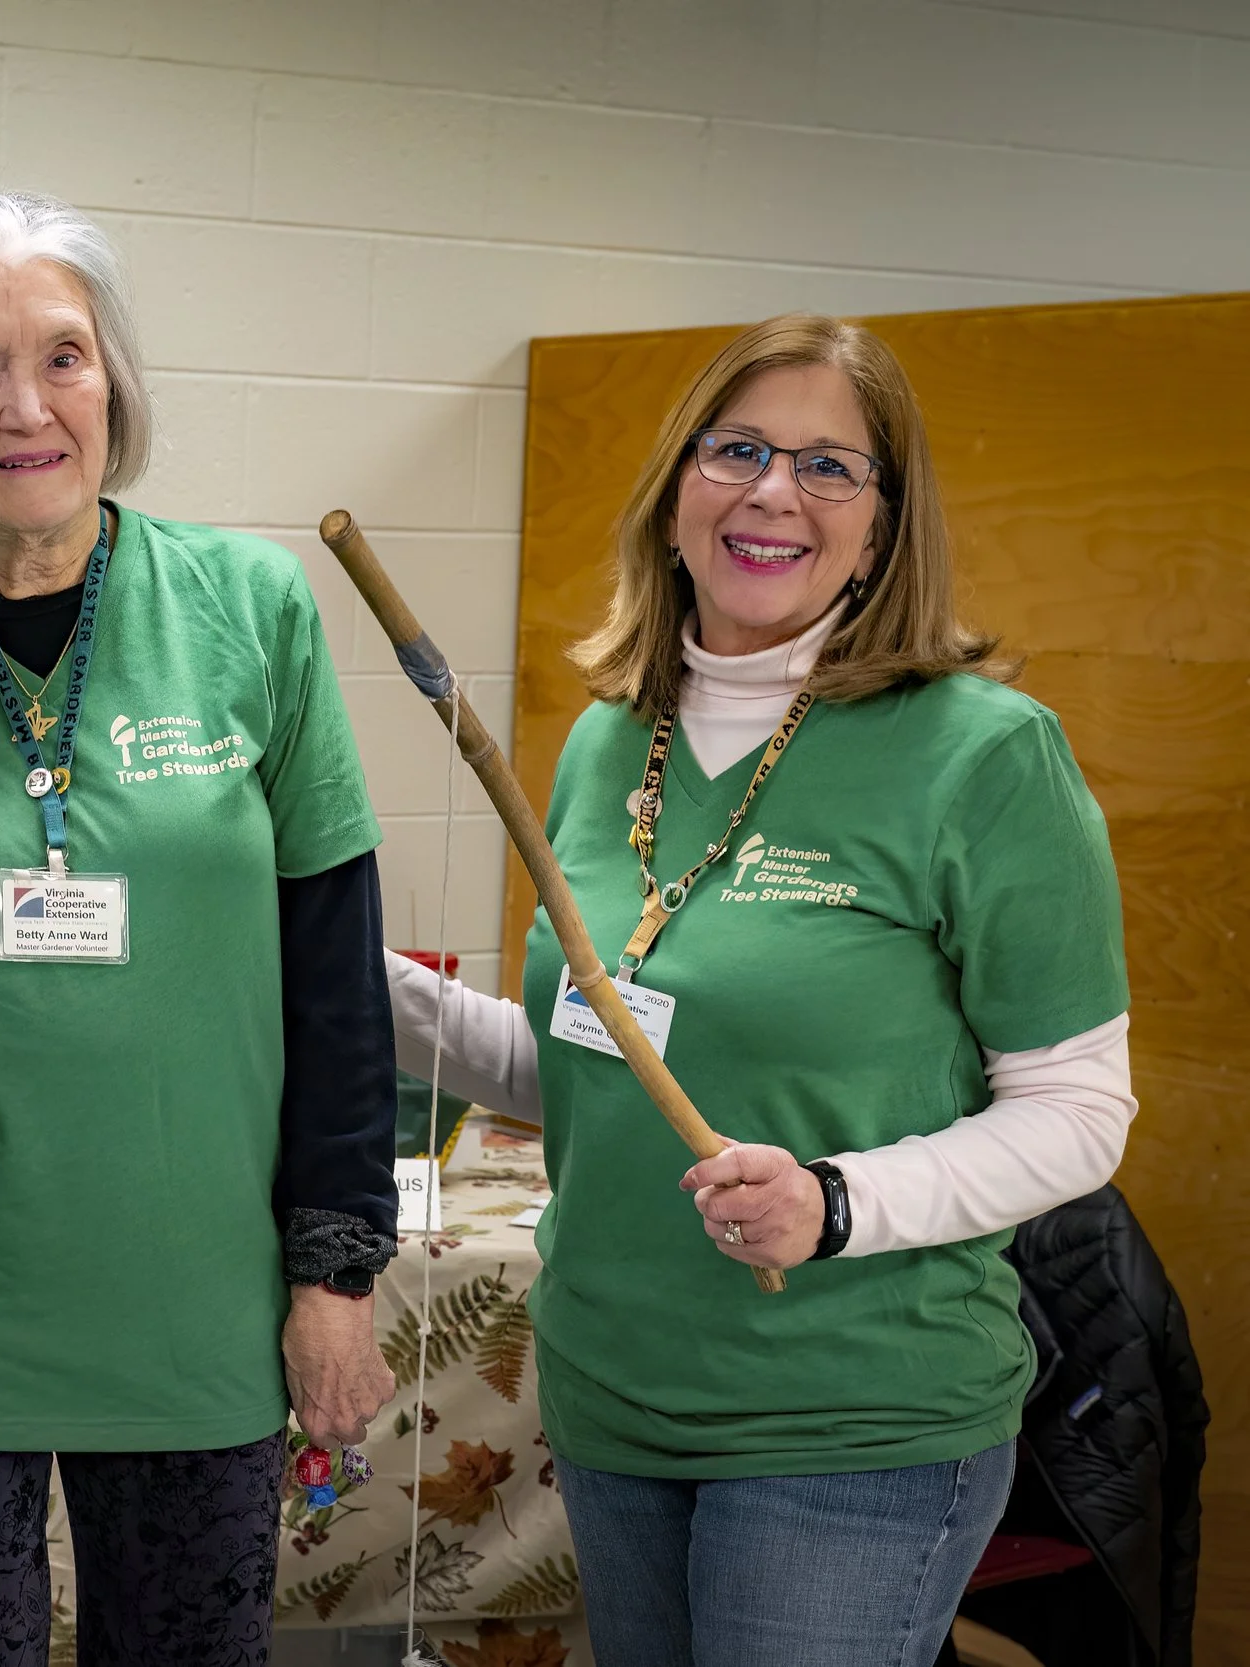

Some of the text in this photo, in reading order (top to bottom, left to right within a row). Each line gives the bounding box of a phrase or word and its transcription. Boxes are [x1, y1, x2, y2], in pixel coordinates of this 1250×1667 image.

[79, 556, 105, 643] MASTER
[57, 655, 87, 767] GARDENER
[138, 715, 202, 731] Extension
[140, 728, 188, 744] Master
[142, 734, 243, 760] Gardeners
[115, 751, 249, 785] Tree Stewards
[767, 845, 831, 862] Extension
[761, 859, 811, 874] Master
[753, 871, 859, 897] Gardeners
[45, 888, 85, 900] Virginia
[719, 888, 757, 902] Tree
[45, 899, 107, 910] Cooperative
[45, 910, 95, 919] Extension
[16, 929, 108, 941] Betty Anne Ward
[16, 943, 109, 952] Master Gardener Volunteer
[644, 994, 670, 1009] 2020
[570, 1018, 603, 1036] Jayme
[562, 1029, 584, 1041] Master
[585, 1036, 616, 1052] Gardener
